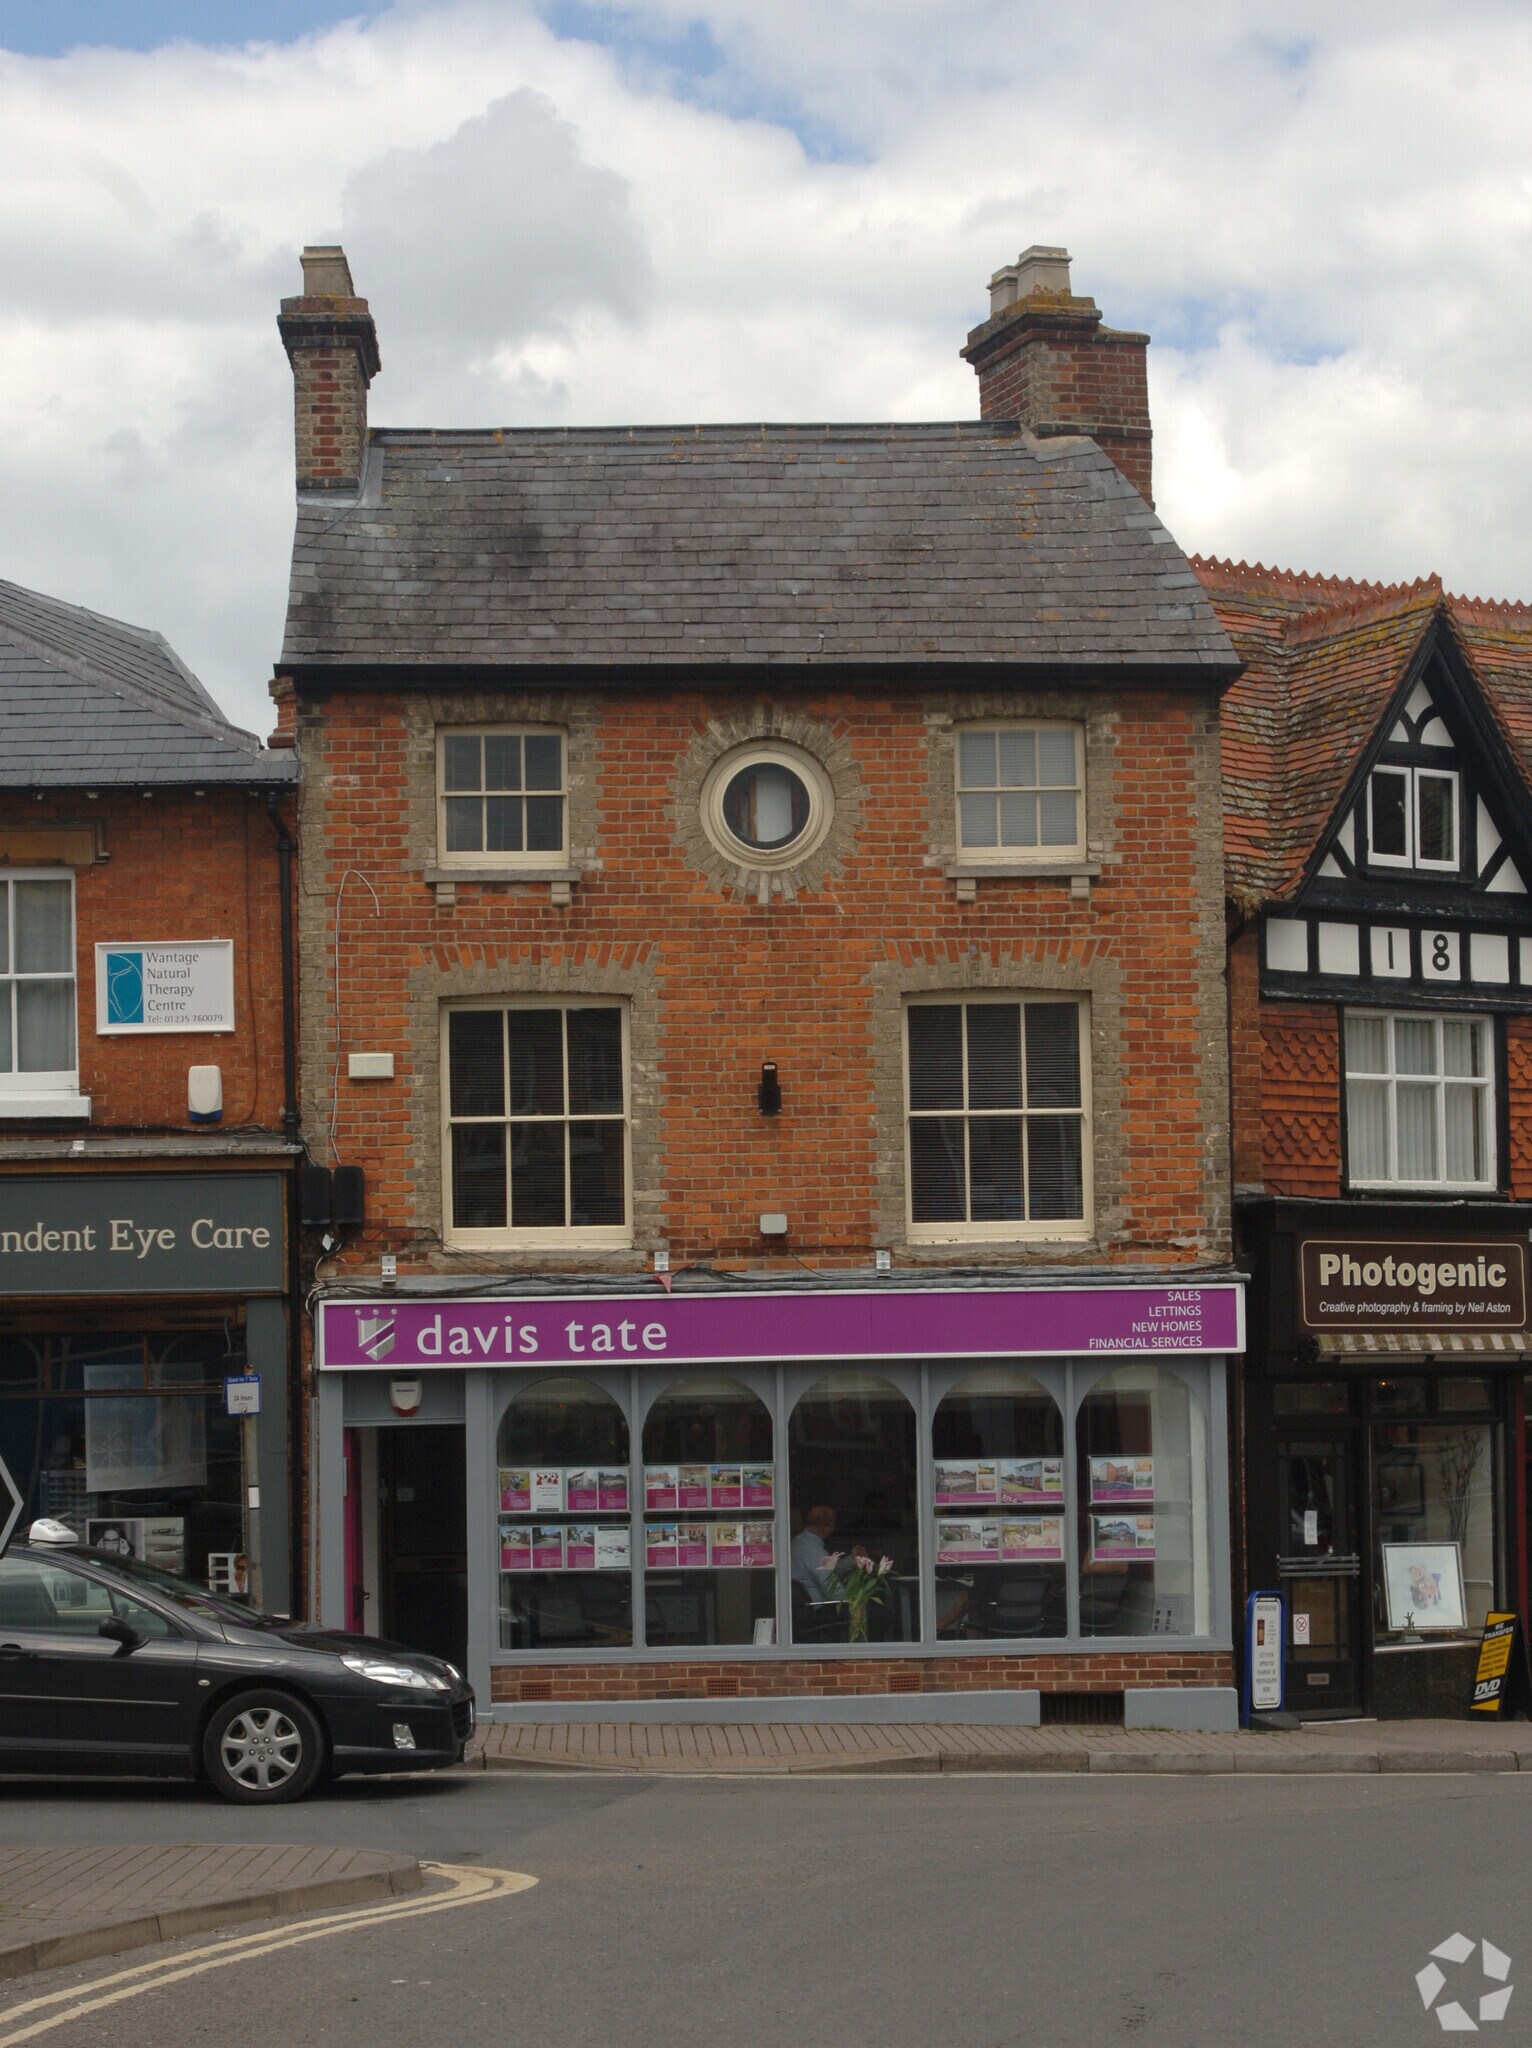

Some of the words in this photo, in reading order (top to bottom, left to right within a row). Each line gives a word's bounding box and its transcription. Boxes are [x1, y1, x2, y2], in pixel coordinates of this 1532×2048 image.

[146, 951, 200, 965] Wantage
[147, 967, 191, 979] Natural
[147, 983, 195, 997] Therapy
[147, 999, 186, 1011] Centre
[147, 1015, 162, 1023] Tel:
[164, 1014, 190, 1023] 01235
[193, 1014, 223, 1022] 760079
[0, 1222, 97, 1252] ndent
[109, 1220, 176, 1259] Eye
[191, 1218, 271, 1249] Care
[1319, 1253, 1507, 1295] Photogenic
[1167, 1290, 1201, 1302] SALES
[1148, 1305, 1202, 1317] LETTINGS
[1319, 1301, 1355, 1313] Creative
[1357, 1301, 1411, 1315] photography
[1412, 1302, 1420, 1313] &
[1421, 1302, 1454, 1315] framing
[1455, 1302, 1466, 1315] by
[1467, 1302, 1485, 1313] Neil
[1486, 1302, 1511, 1313] Aston
[1132, 1321, 1159, 1333] NEW
[1161, 1320, 1202, 1332] HOMES
[416, 1314, 539, 1356] davis
[564, 1319, 668, 1353] tate
[1089, 1337, 1149, 1349] FINANCIAL
[1151, 1335, 1203, 1348] SERVICES
[1484, 1626, 1514, 1640] TRANSFER
[1475, 1679, 1501, 1695] DVD
